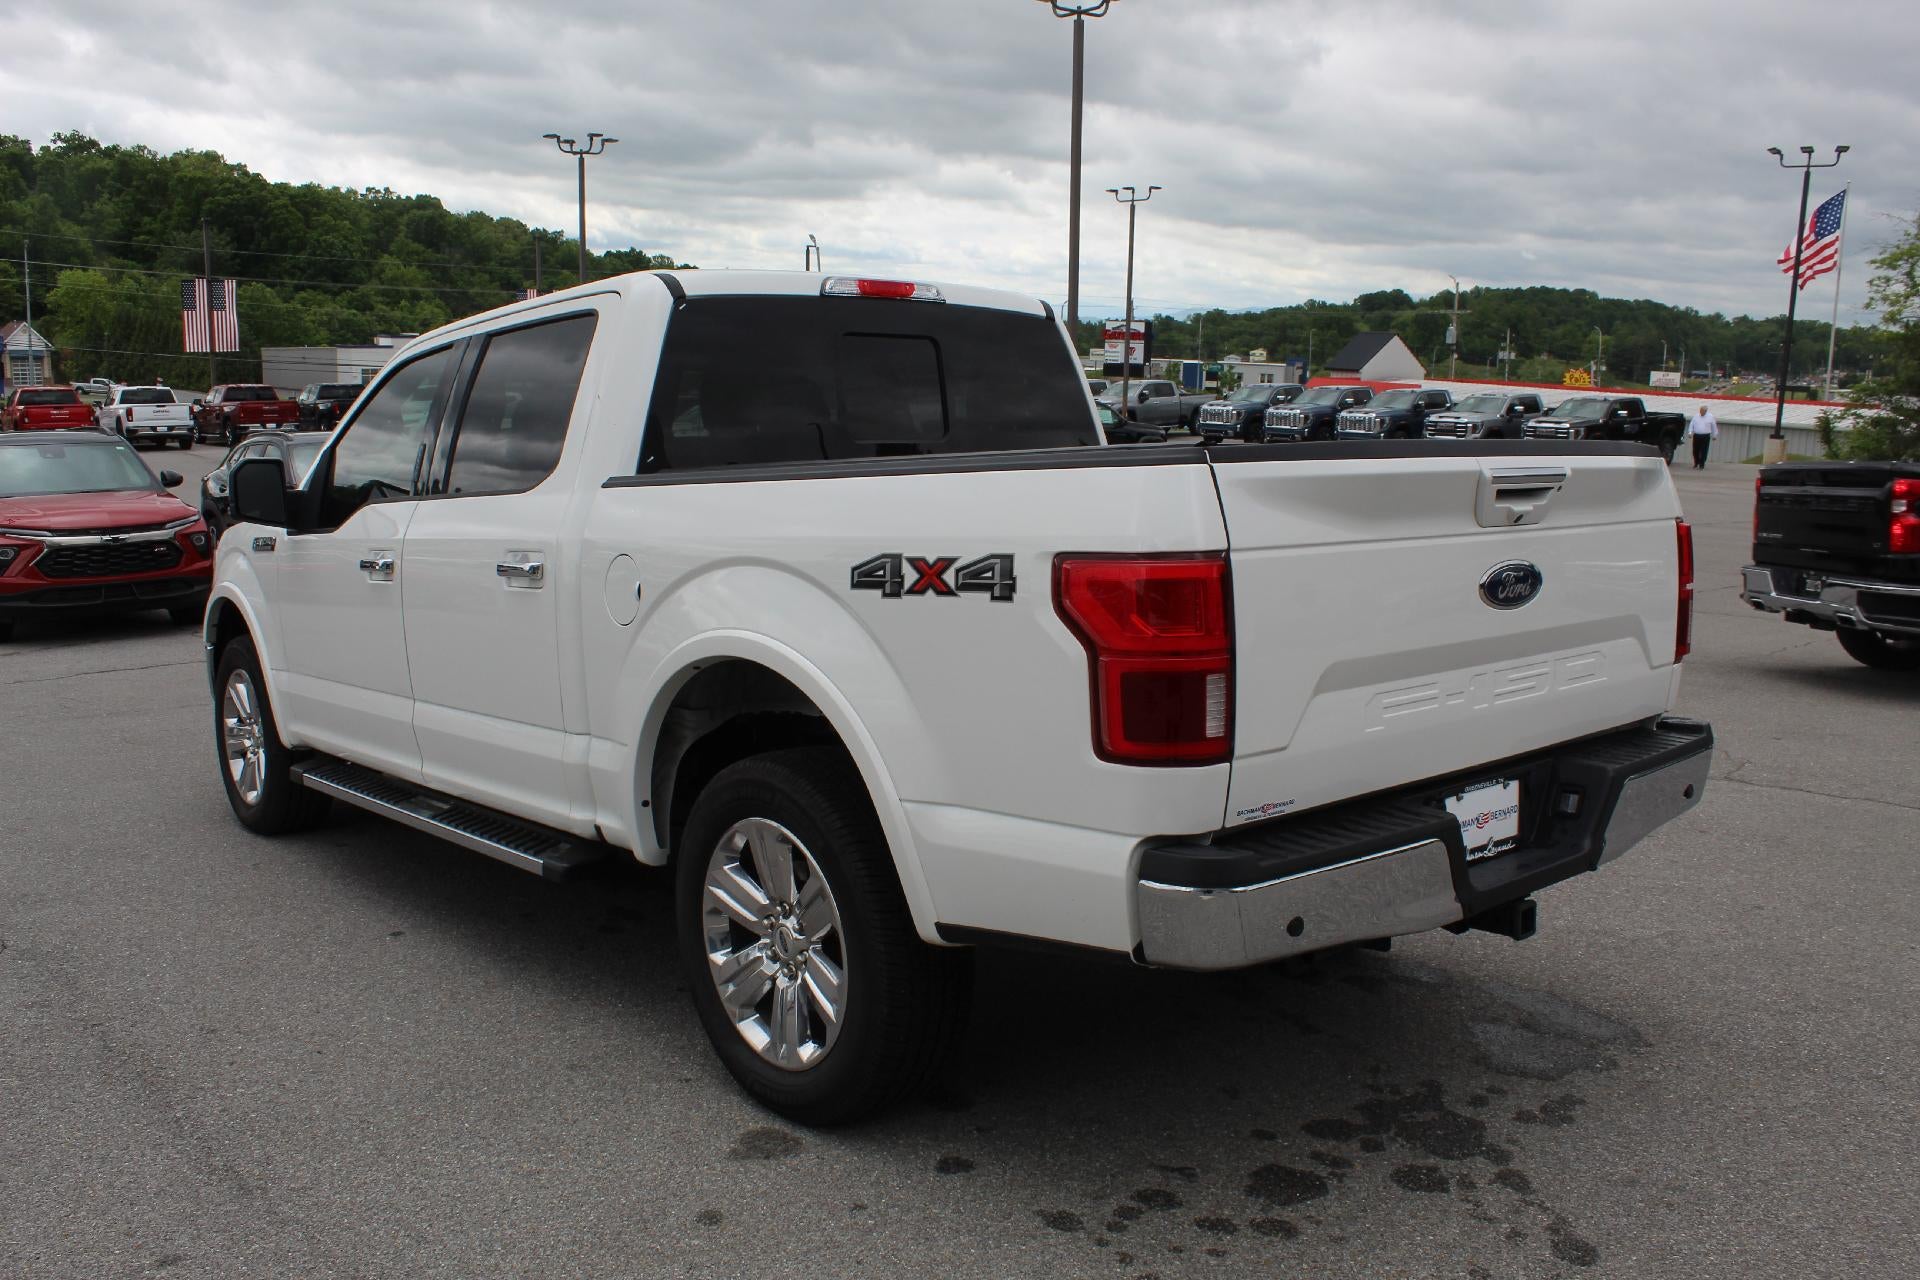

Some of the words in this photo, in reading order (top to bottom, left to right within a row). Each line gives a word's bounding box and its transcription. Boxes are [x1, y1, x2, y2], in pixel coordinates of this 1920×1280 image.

[1498, 571, 1531, 599] Ford
[1365, 650, 1608, 732] F-150
[1490, 804, 1519, 821] BERNARD
